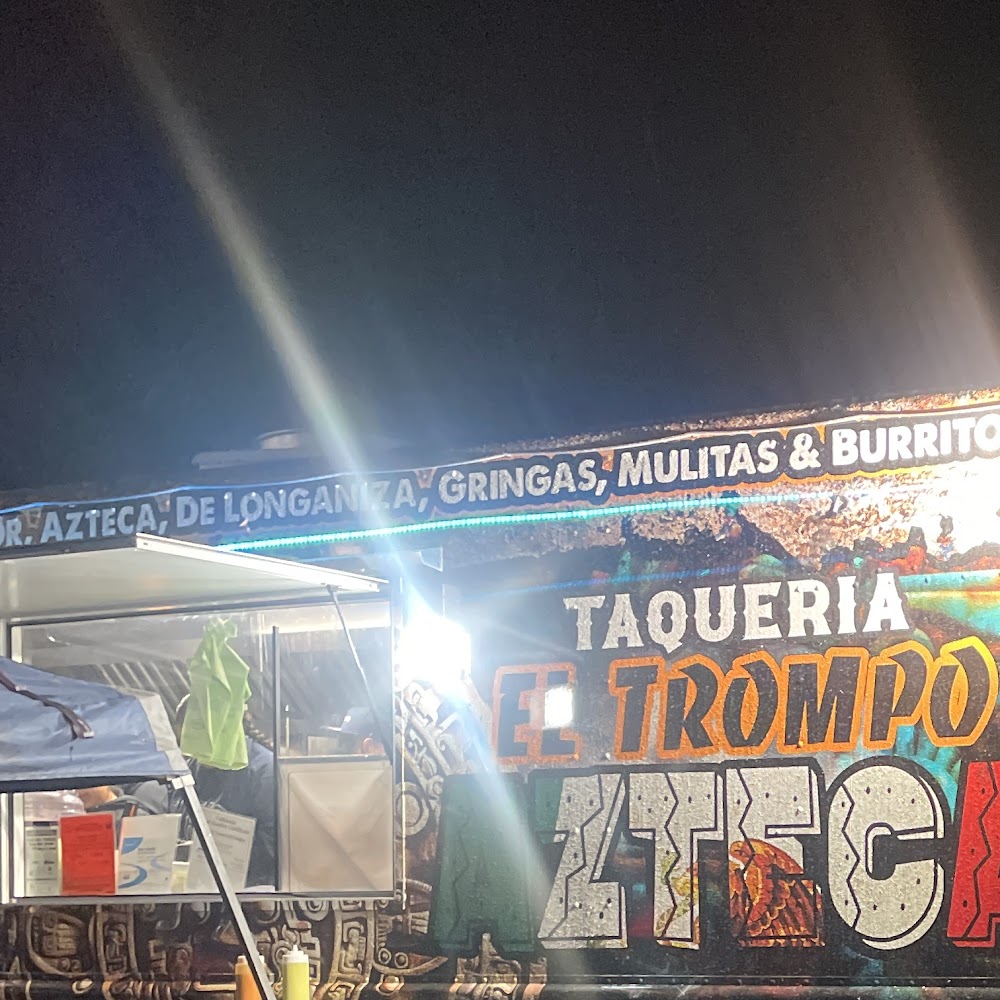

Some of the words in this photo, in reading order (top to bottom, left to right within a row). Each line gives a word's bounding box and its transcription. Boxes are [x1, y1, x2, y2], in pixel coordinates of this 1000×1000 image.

[40, 502, 168, 544] AZTECA,
[176, 494, 216, 528] DE
[224, 476, 429, 524] LONGANIZA,
[438, 456, 606, 506] GRINGAS,
[617, 439, 777, 487] MULITAS
[789, 432, 820, 470] &
[562, 572, 911, 654] TAQUERIA
[493, 661, 584, 765] EL
[608, 635, 1000, 761] TROMPO
